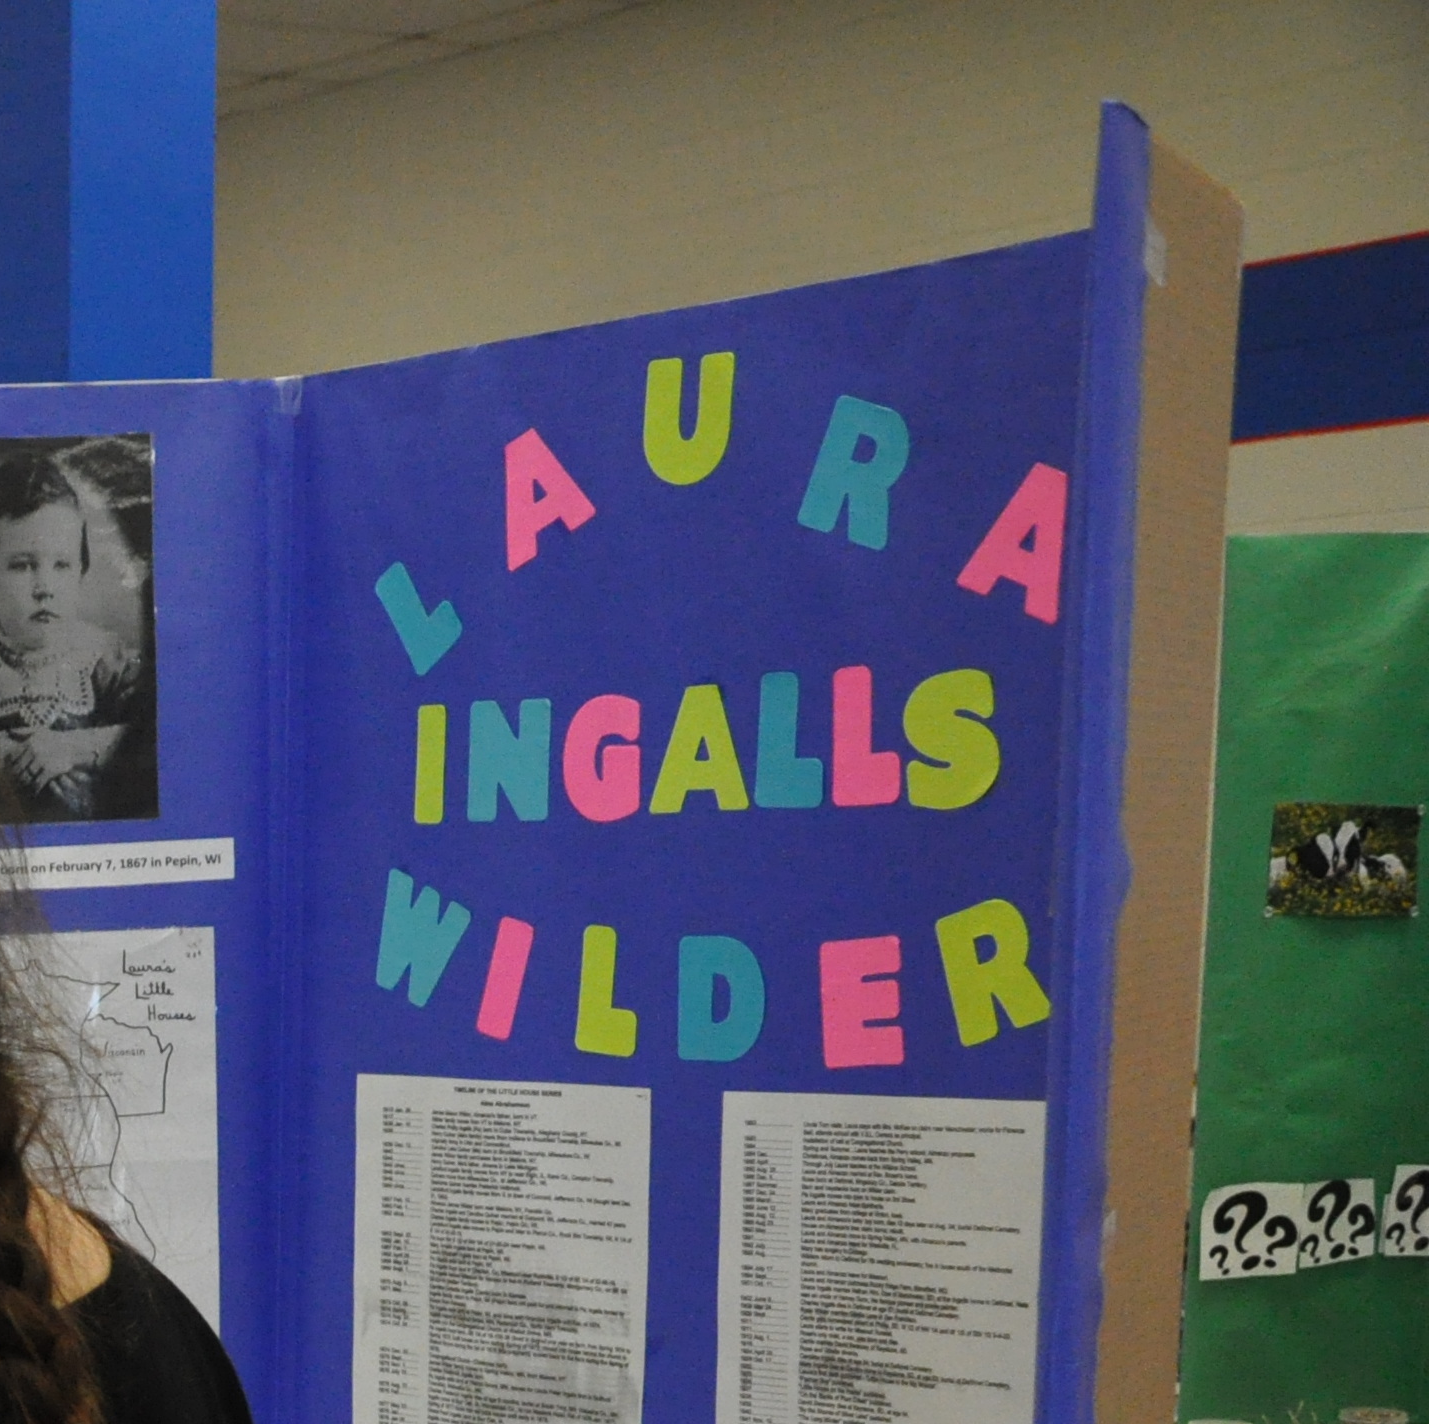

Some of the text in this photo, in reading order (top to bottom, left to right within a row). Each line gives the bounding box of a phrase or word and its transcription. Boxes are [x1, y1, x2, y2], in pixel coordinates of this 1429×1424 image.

[375, 351, 1068, 677] LAURA
[414, 665, 1001, 825] INGALLS
[31, 864, 46, 874] on
[49, 860, 102, 873] February
[105, 859, 117, 871] 7,
[119, 857, 148, 869] 1867
[150, 856, 162, 867] in
[165, 855, 202, 868] Pepin,
[204, 853, 222, 865] WI
[122, 949, 176, 976] Laura's
[375, 867, 1052, 1070] WILDER
[136, 981, 174, 999] Little
[147, 1004, 196, 1021] Houses
